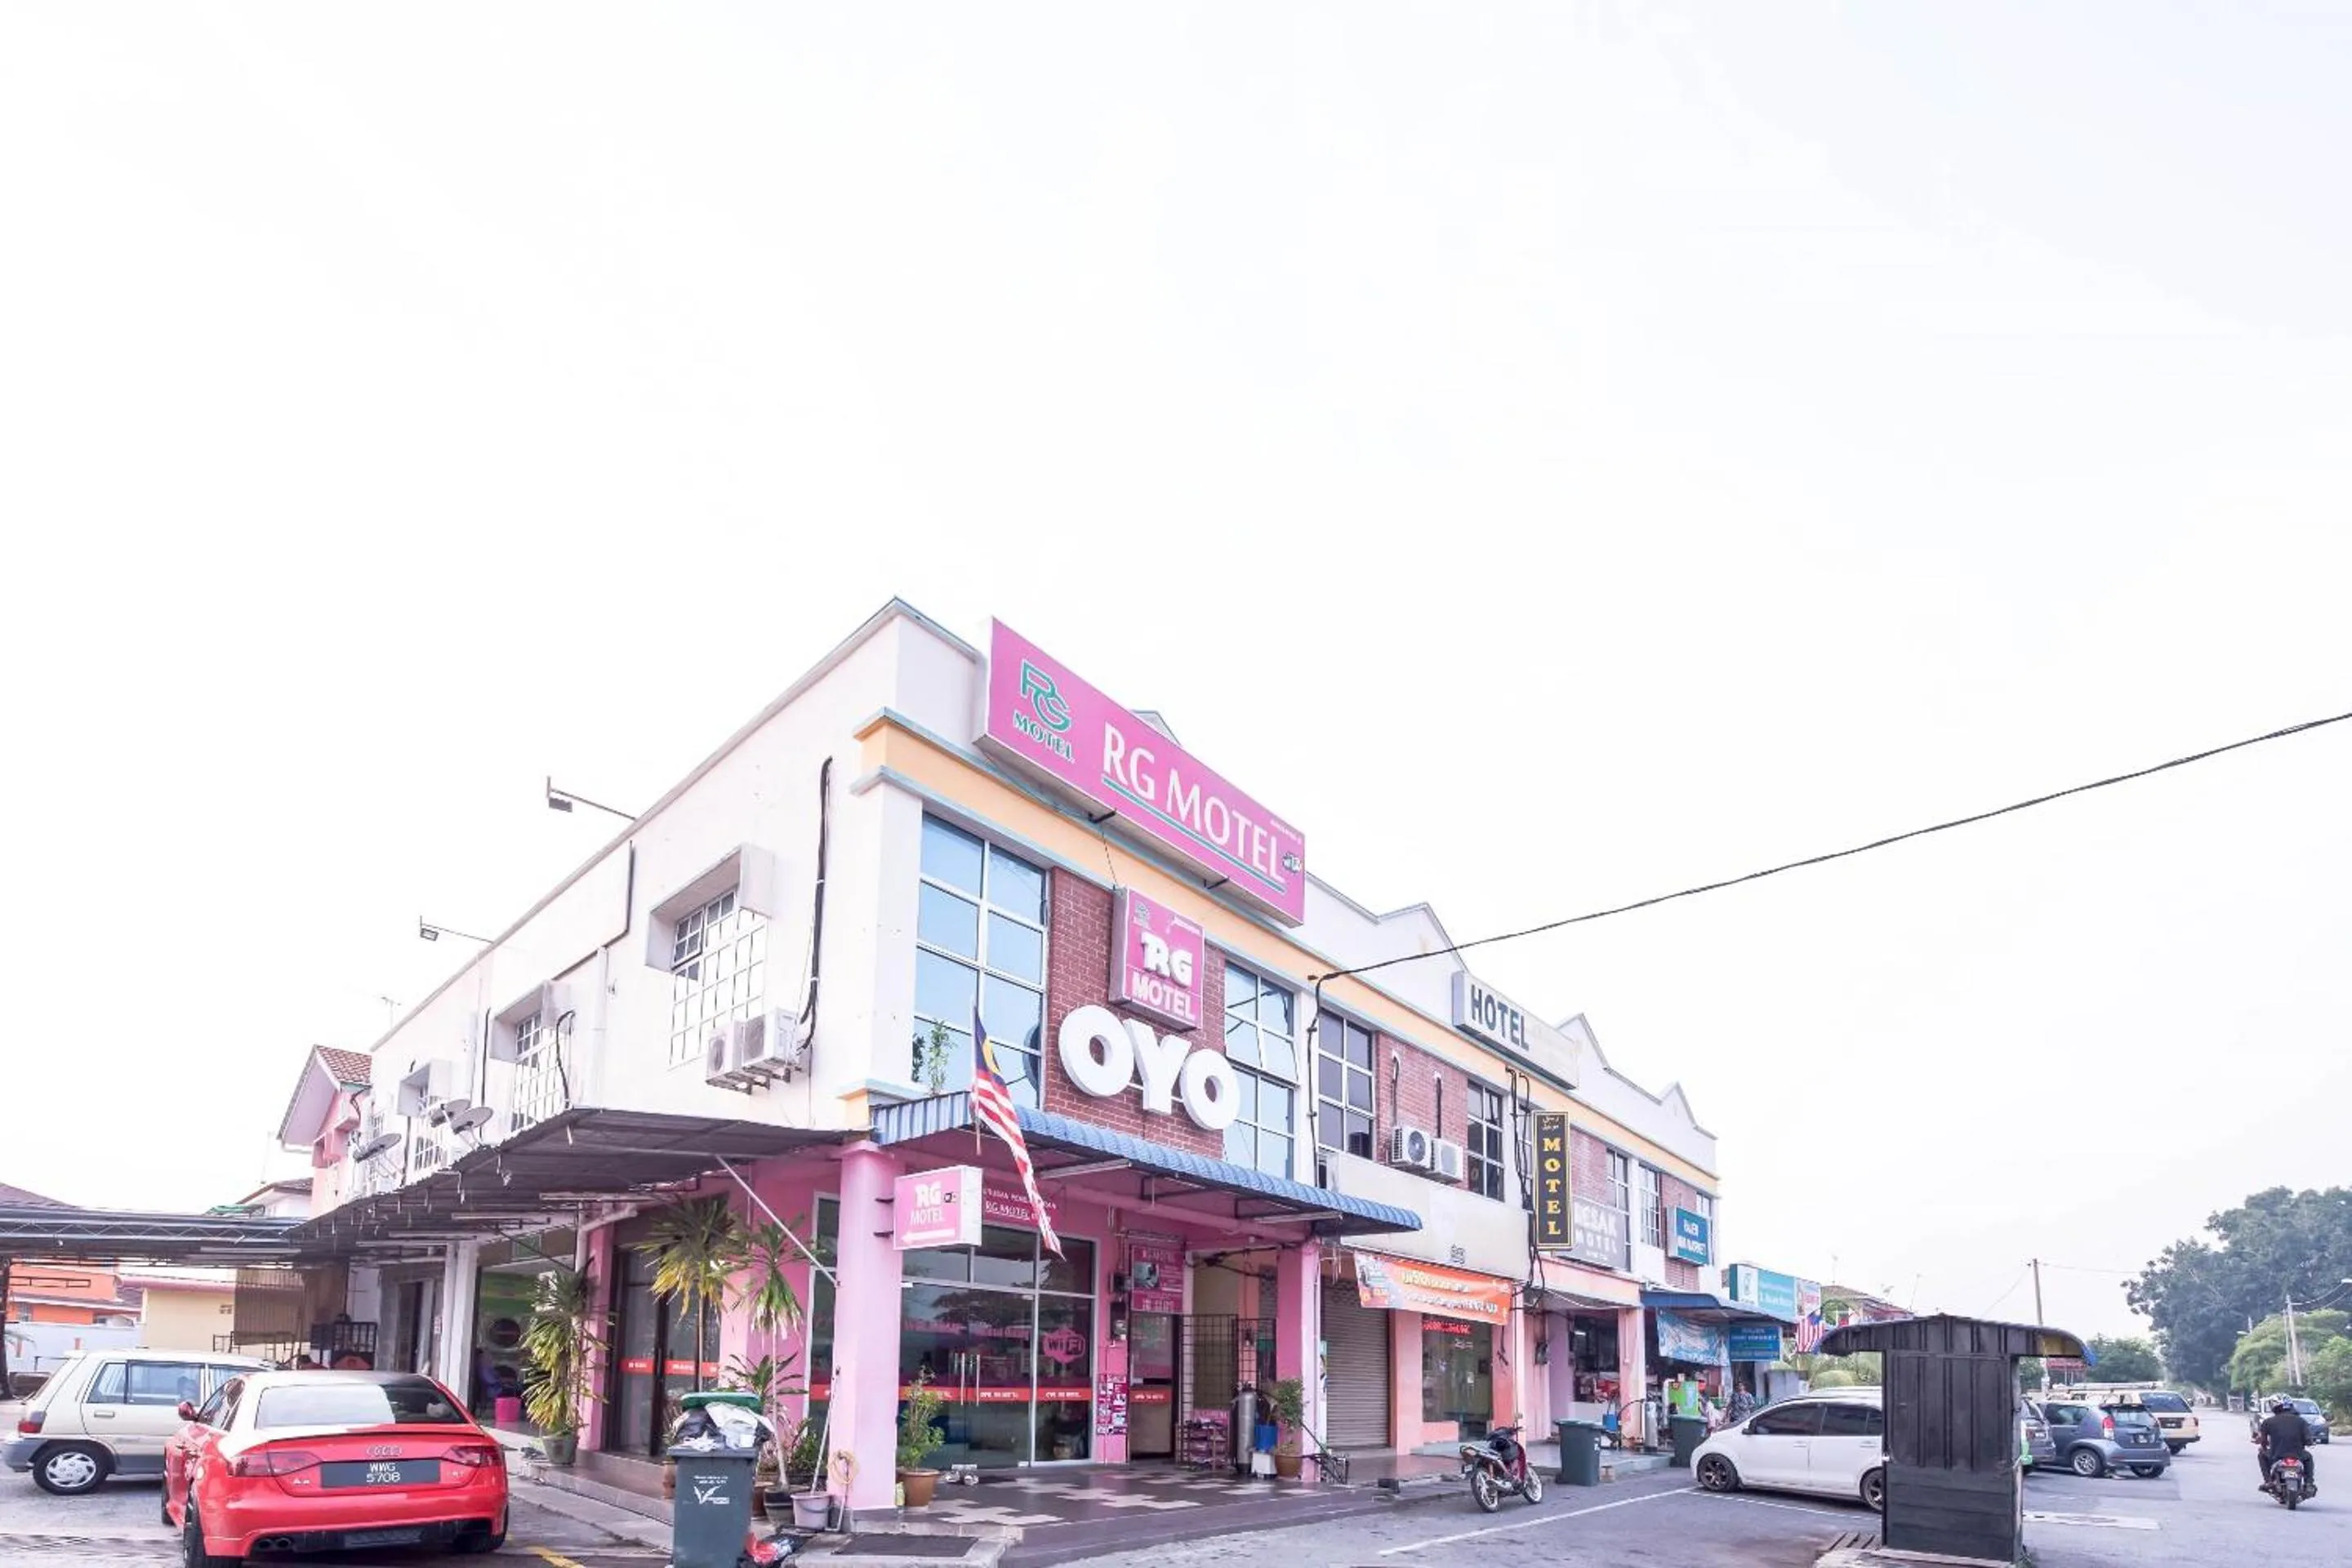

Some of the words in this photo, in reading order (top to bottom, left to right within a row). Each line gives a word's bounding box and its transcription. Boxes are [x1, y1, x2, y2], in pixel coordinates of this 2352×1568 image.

[1013, 709, 1077, 764] MOTEL
[1103, 722, 1156, 802] RG
[1166, 768, 1287, 884] MOTEL
[1141, 931, 1193, 987] RG
[1132, 972, 1196, 1018] MOTEL
[1471, 984, 1530, 1051] HOTEL
[1058, 1004, 1241, 1130] OYO
[915, 1181, 942, 1208] RG
[1543, 1138, 1561, 1235] MOTEL
[910, 1207, 945, 1226] MOTEL
[1575, 1228, 1617, 1254] MOTEL
[369, 1462, 396, 1472] WWG
